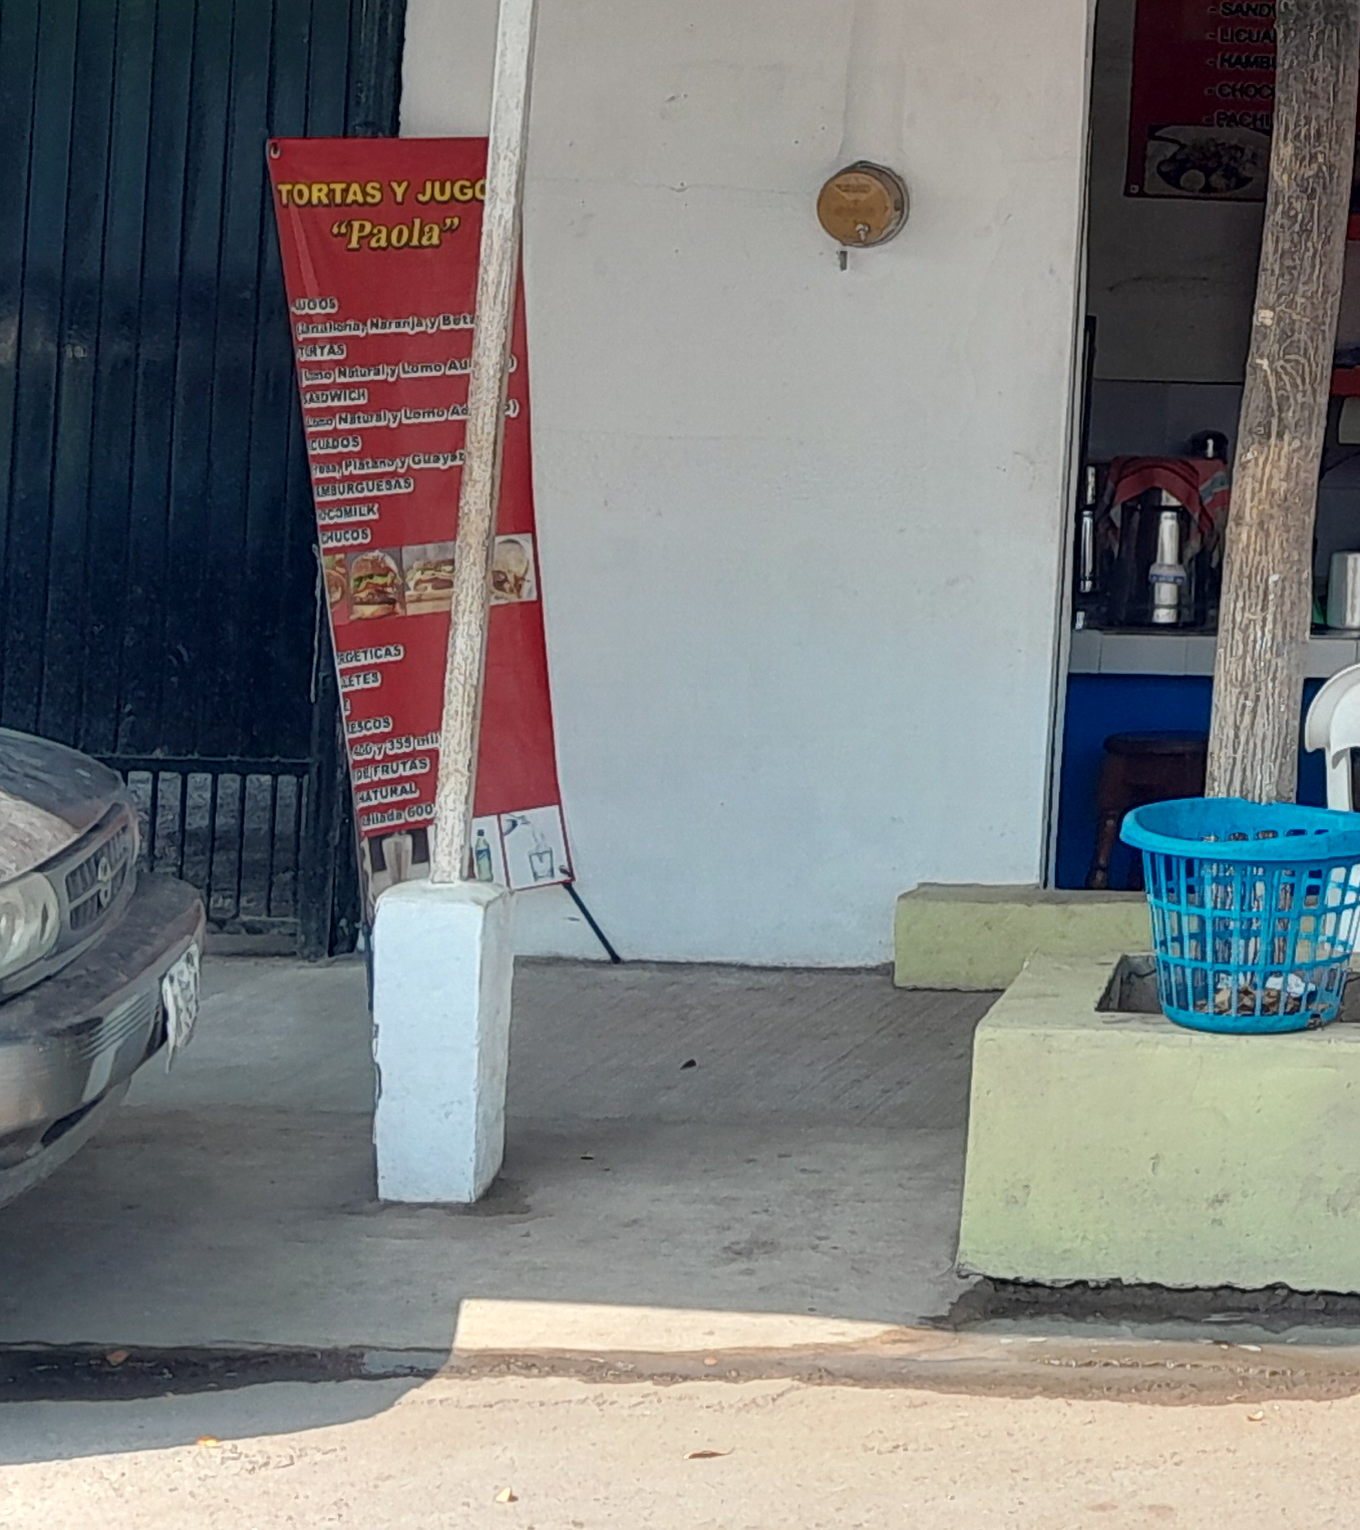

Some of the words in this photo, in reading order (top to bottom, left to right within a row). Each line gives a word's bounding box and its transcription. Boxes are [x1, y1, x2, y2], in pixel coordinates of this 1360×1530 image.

[276, 181, 384, 207] TORTAS
[390, 180, 411, 205] Y
[416, 178, 486, 203] JUGO
[372, 757, 429, 778] FRUTAS
